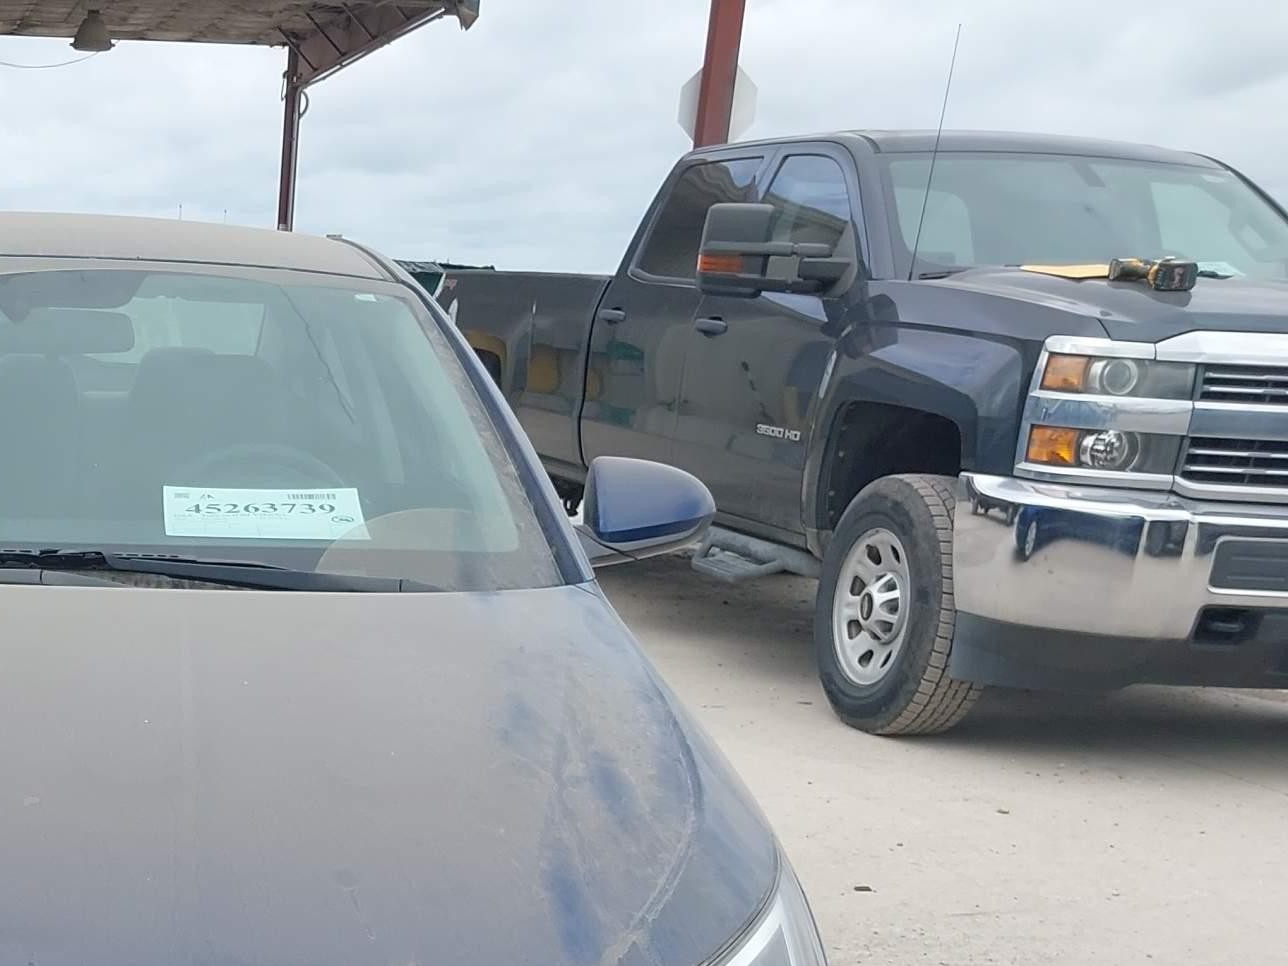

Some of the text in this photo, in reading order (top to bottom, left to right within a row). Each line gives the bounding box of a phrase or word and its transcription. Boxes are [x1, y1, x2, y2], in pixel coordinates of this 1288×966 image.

[756, 423, 801, 441] 3500 HD
[185, 502, 336, 514] 45263739
